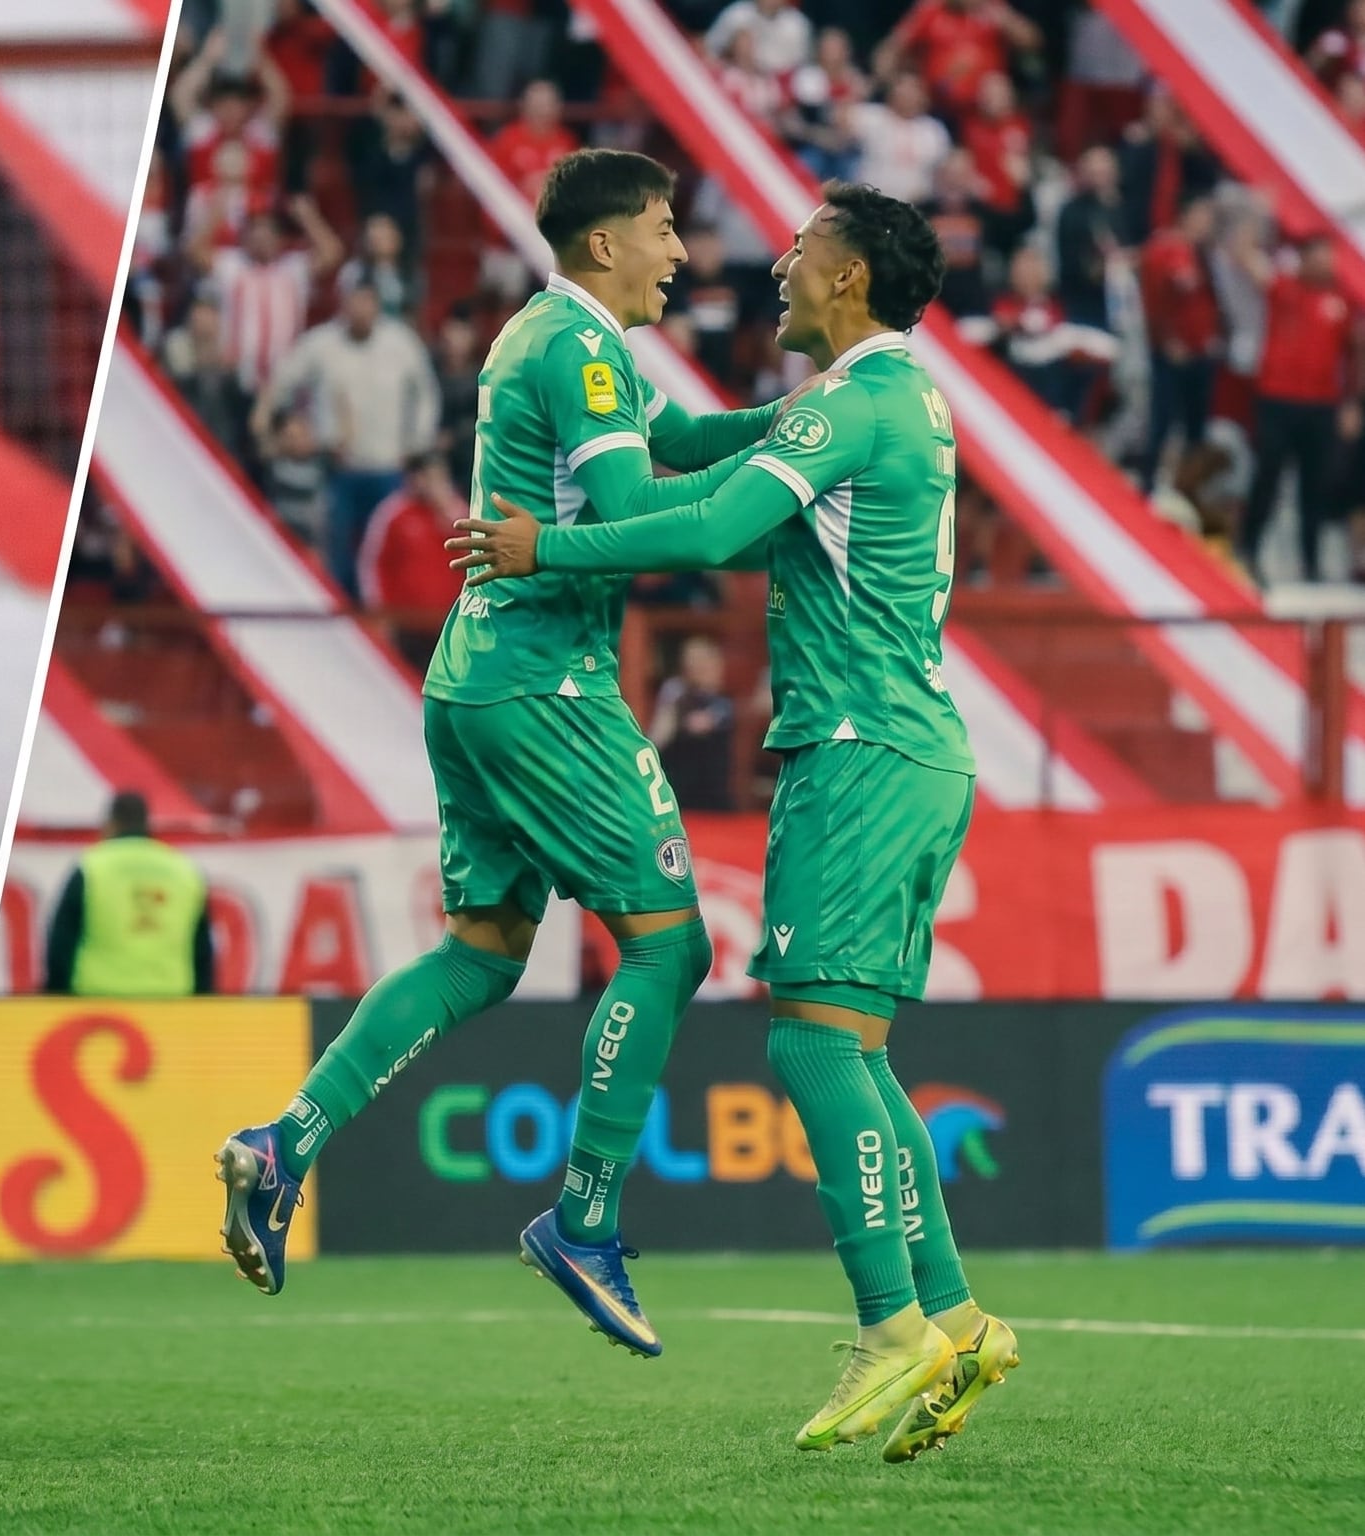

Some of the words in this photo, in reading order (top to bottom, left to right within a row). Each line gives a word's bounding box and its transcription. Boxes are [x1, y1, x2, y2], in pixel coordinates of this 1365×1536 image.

[590, 1000, 636, 1093] IVECO
[856, 1129, 886, 1230] IVECO
[898, 1146, 926, 1244] IVECO
